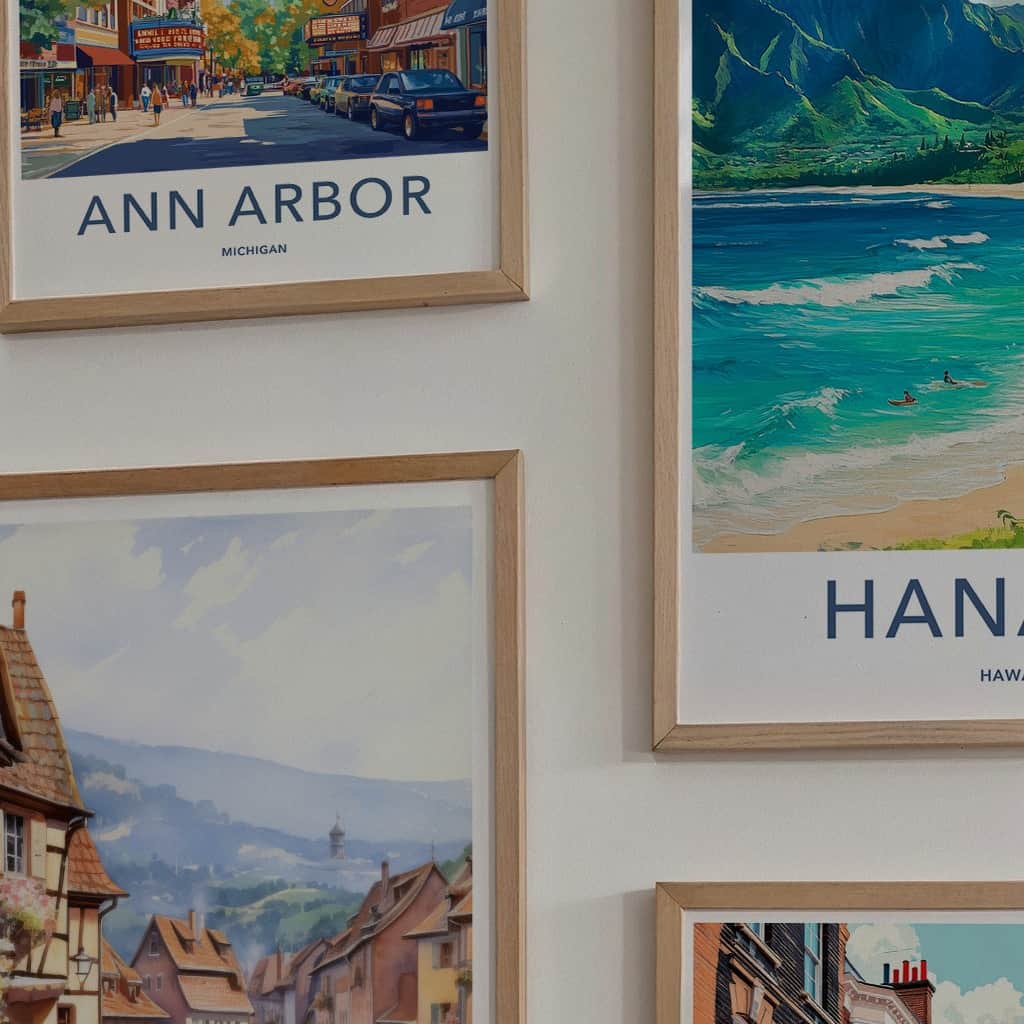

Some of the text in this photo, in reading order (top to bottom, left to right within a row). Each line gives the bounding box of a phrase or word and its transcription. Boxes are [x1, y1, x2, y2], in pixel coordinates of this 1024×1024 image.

[77, 174, 433, 236] ANN ARBOR
[221, 243, 288, 257] MICHIGAN
[826, 577, 1024, 639] HAN
[980, 668, 1024, 682] HAW
